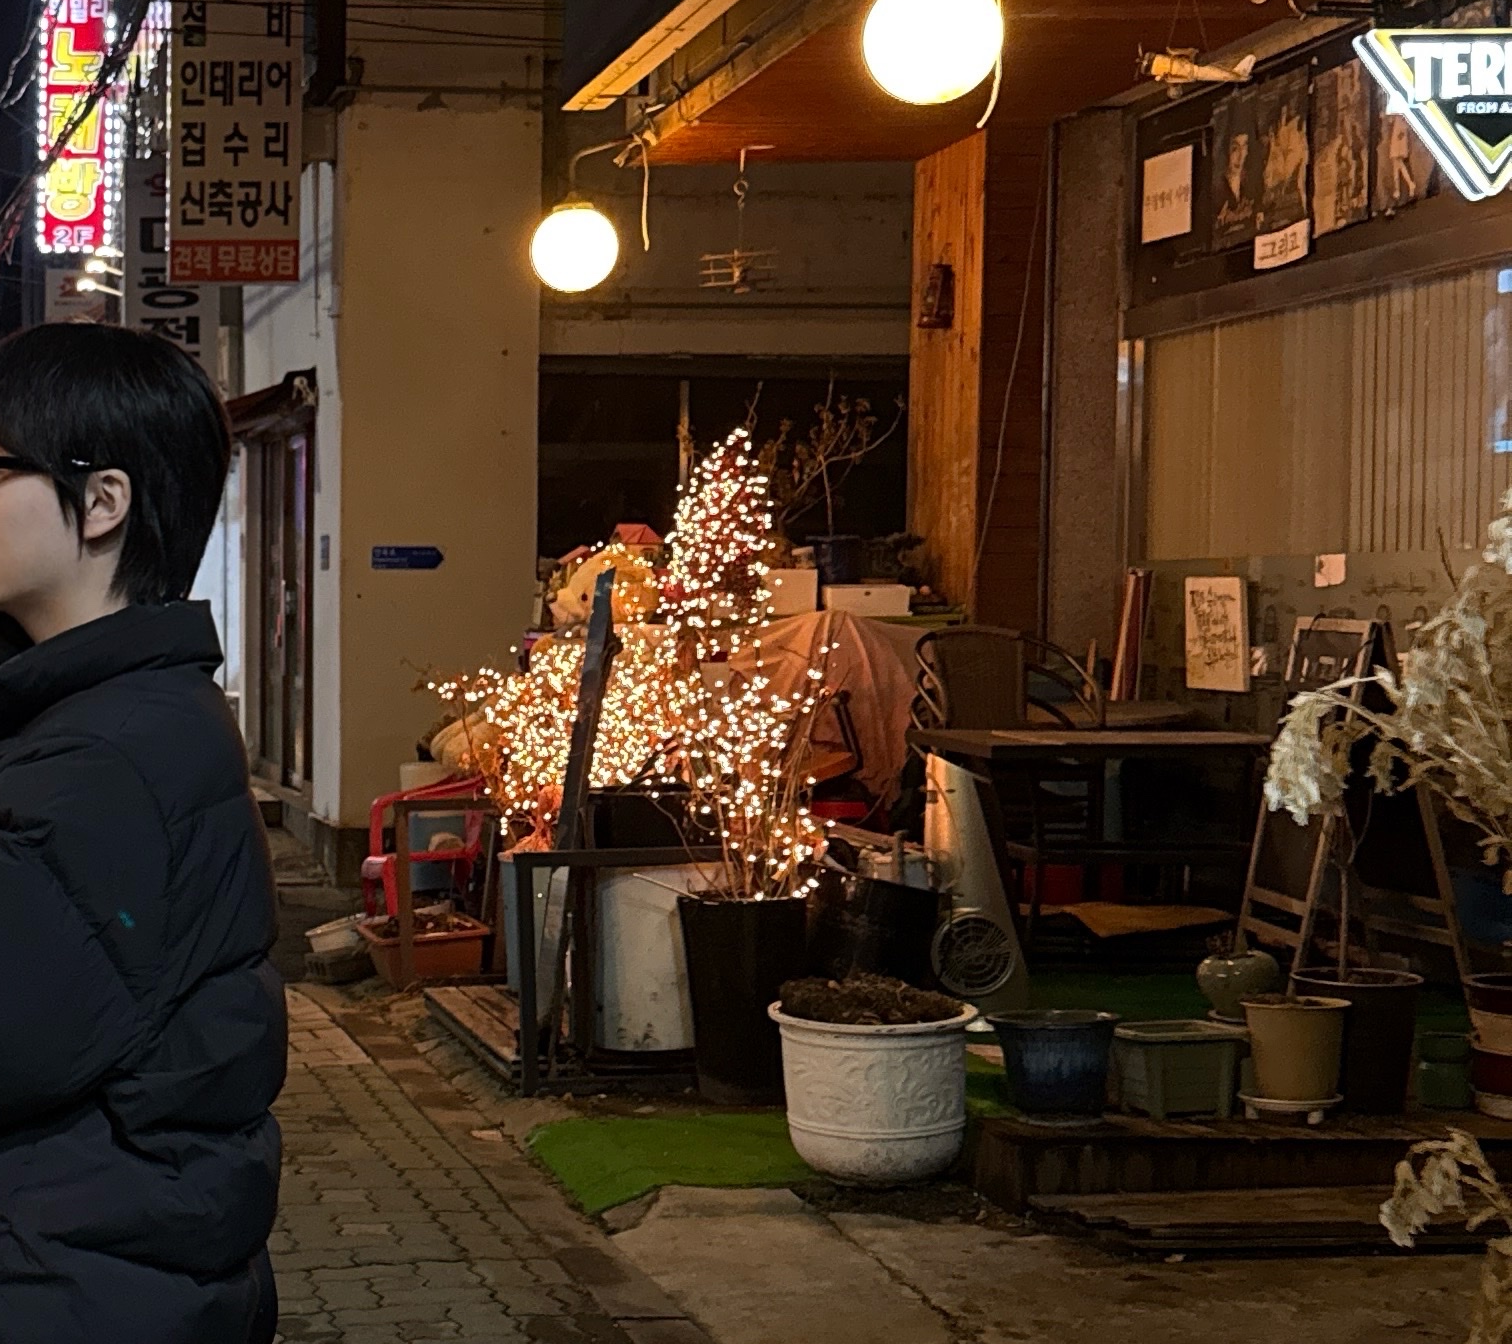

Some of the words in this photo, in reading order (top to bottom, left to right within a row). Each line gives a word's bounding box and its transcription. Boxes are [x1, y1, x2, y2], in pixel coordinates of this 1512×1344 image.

[180, 60, 292, 107] 인테리어
[1400, 41, 1512, 102] TER
[45, 28, 105, 223] 노래방
[1456, 102, 1499, 114] FROM
[180, 179, 292, 228] 신축공사
[51, 225, 96, 246] 2F
[173, 244, 213, 278] 견적
[217, 244, 297, 278] 무료상담
